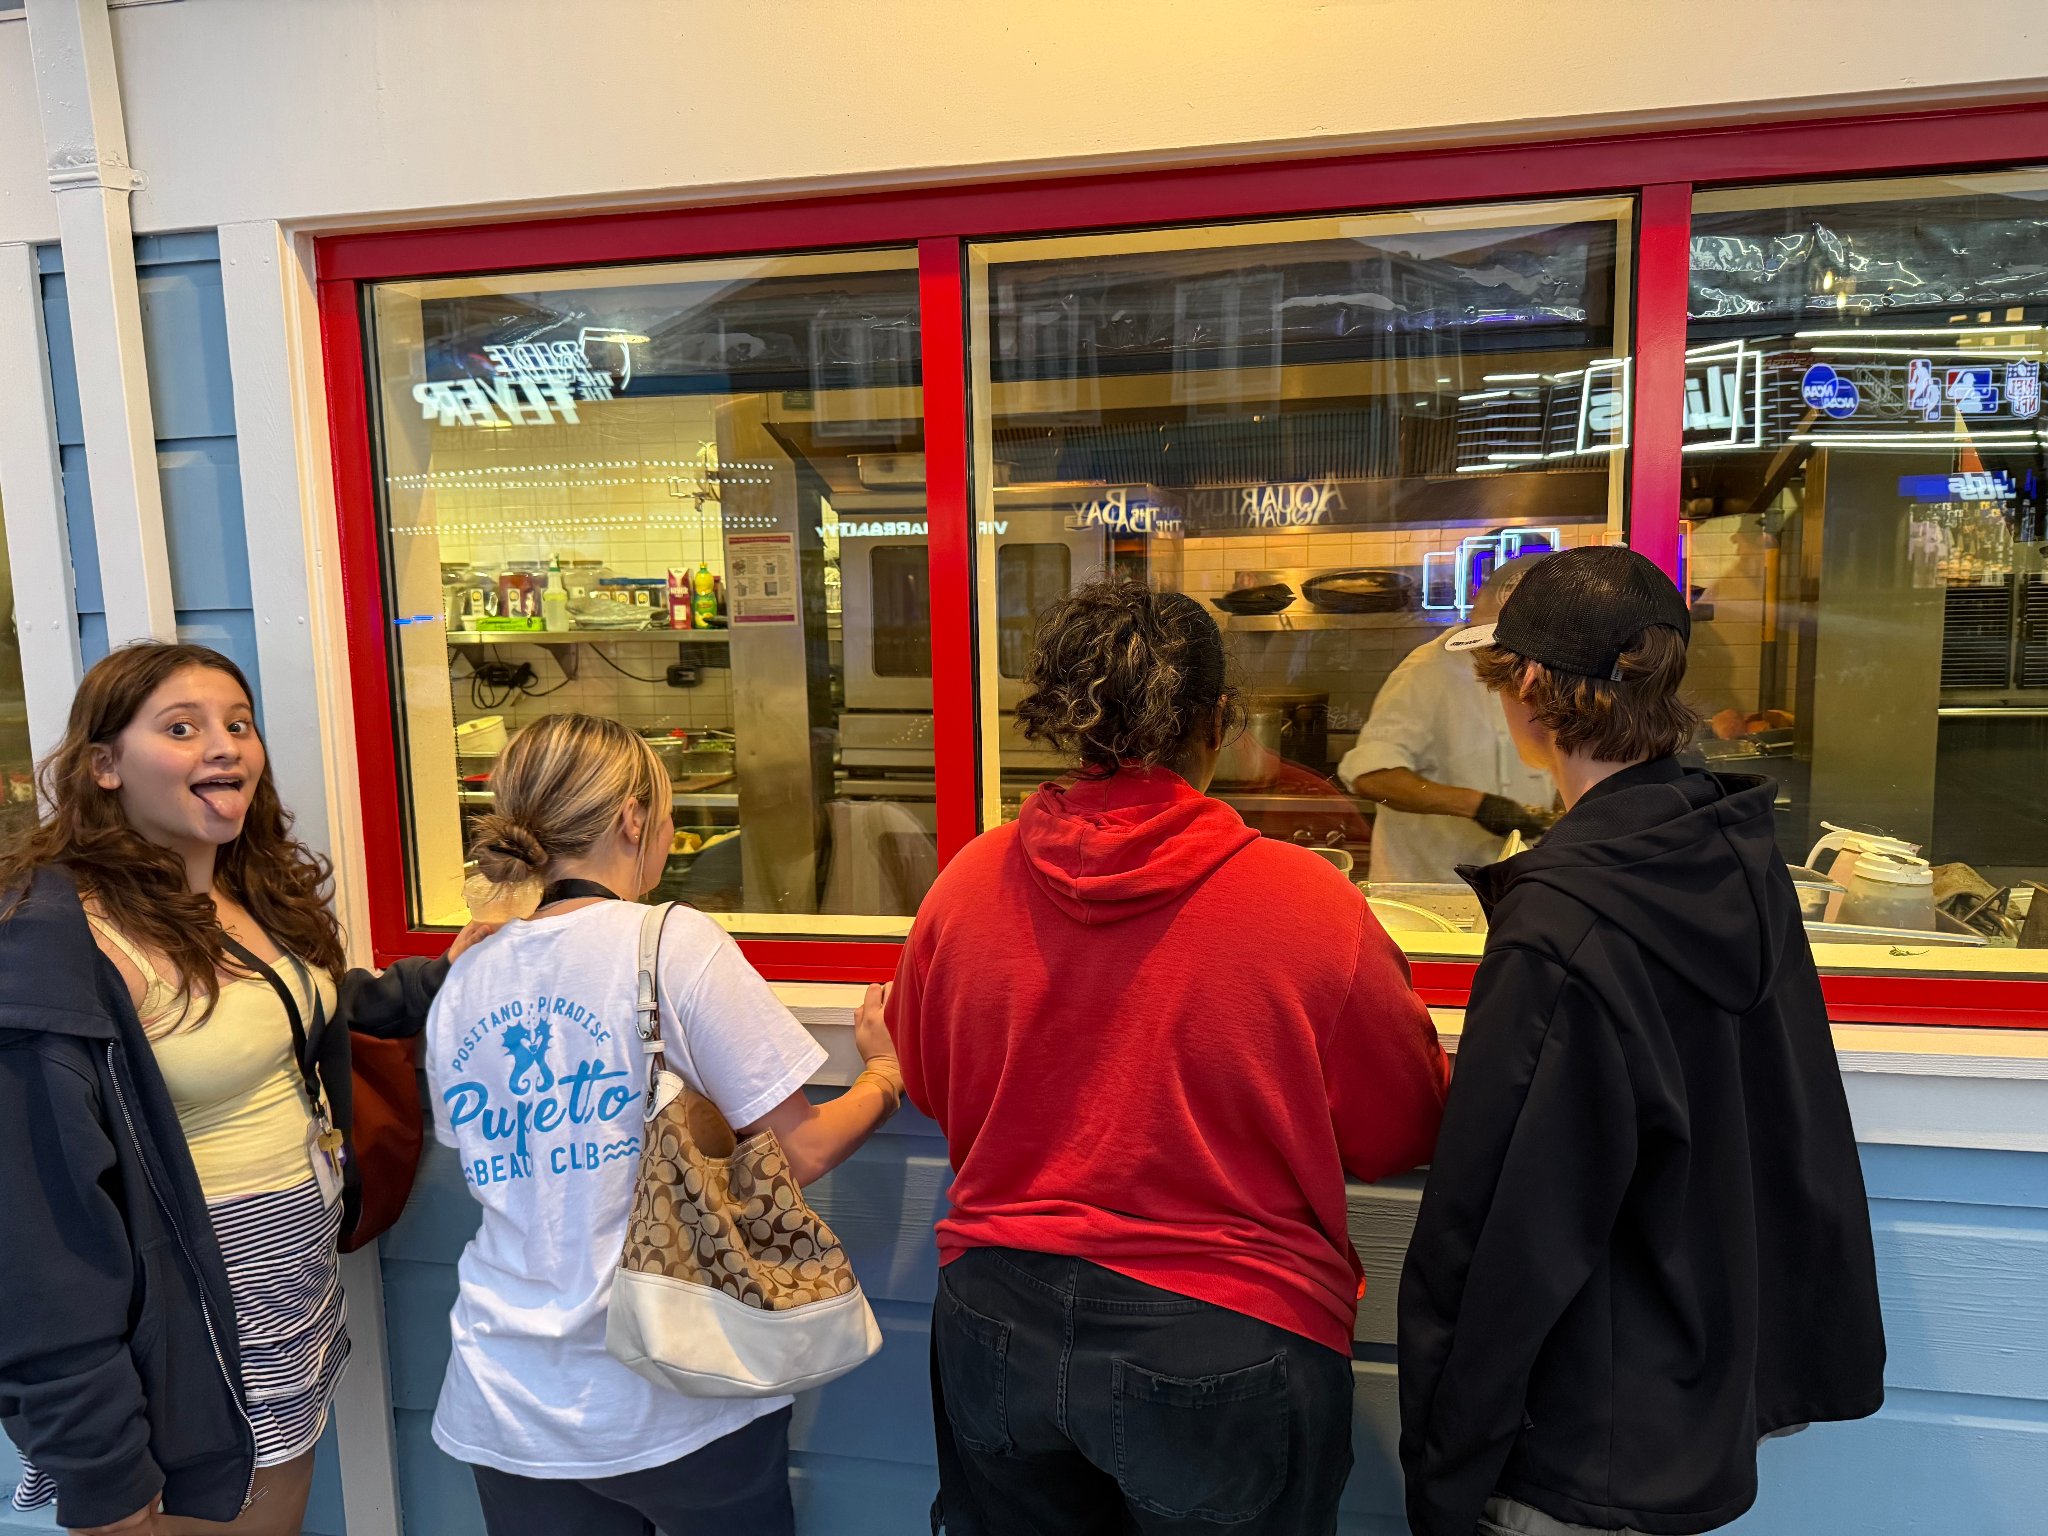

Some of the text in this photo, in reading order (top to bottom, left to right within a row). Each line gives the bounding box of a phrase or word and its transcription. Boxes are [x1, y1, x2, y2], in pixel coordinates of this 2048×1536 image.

[452, 1000, 523, 1073] POSITANO
[474, 1142, 600, 1187] BEAC CLB
